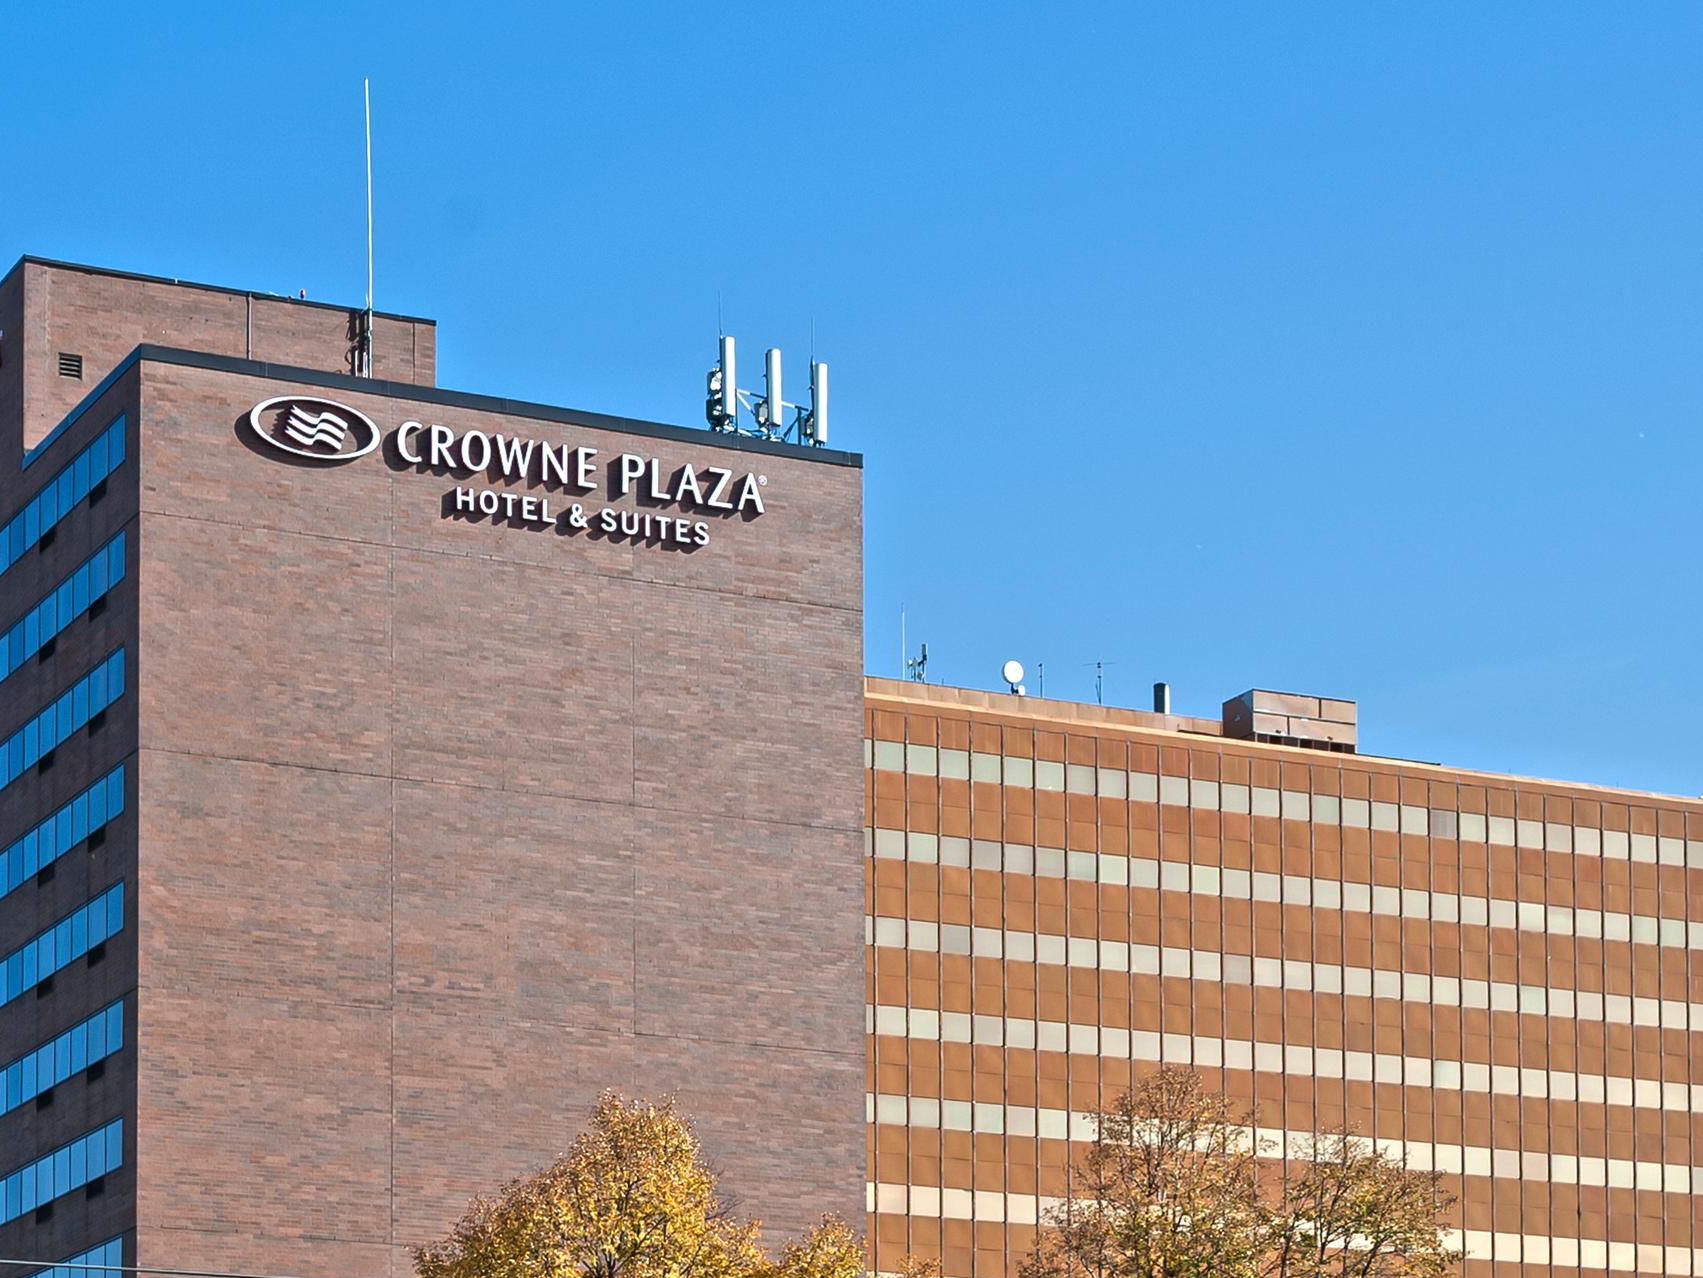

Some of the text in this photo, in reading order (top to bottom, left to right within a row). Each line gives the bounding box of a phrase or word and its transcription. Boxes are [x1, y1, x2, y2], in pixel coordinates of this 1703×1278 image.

[397, 420, 599, 490] CROWNE
[455, 486, 711, 547] HOTEL & SUITES
